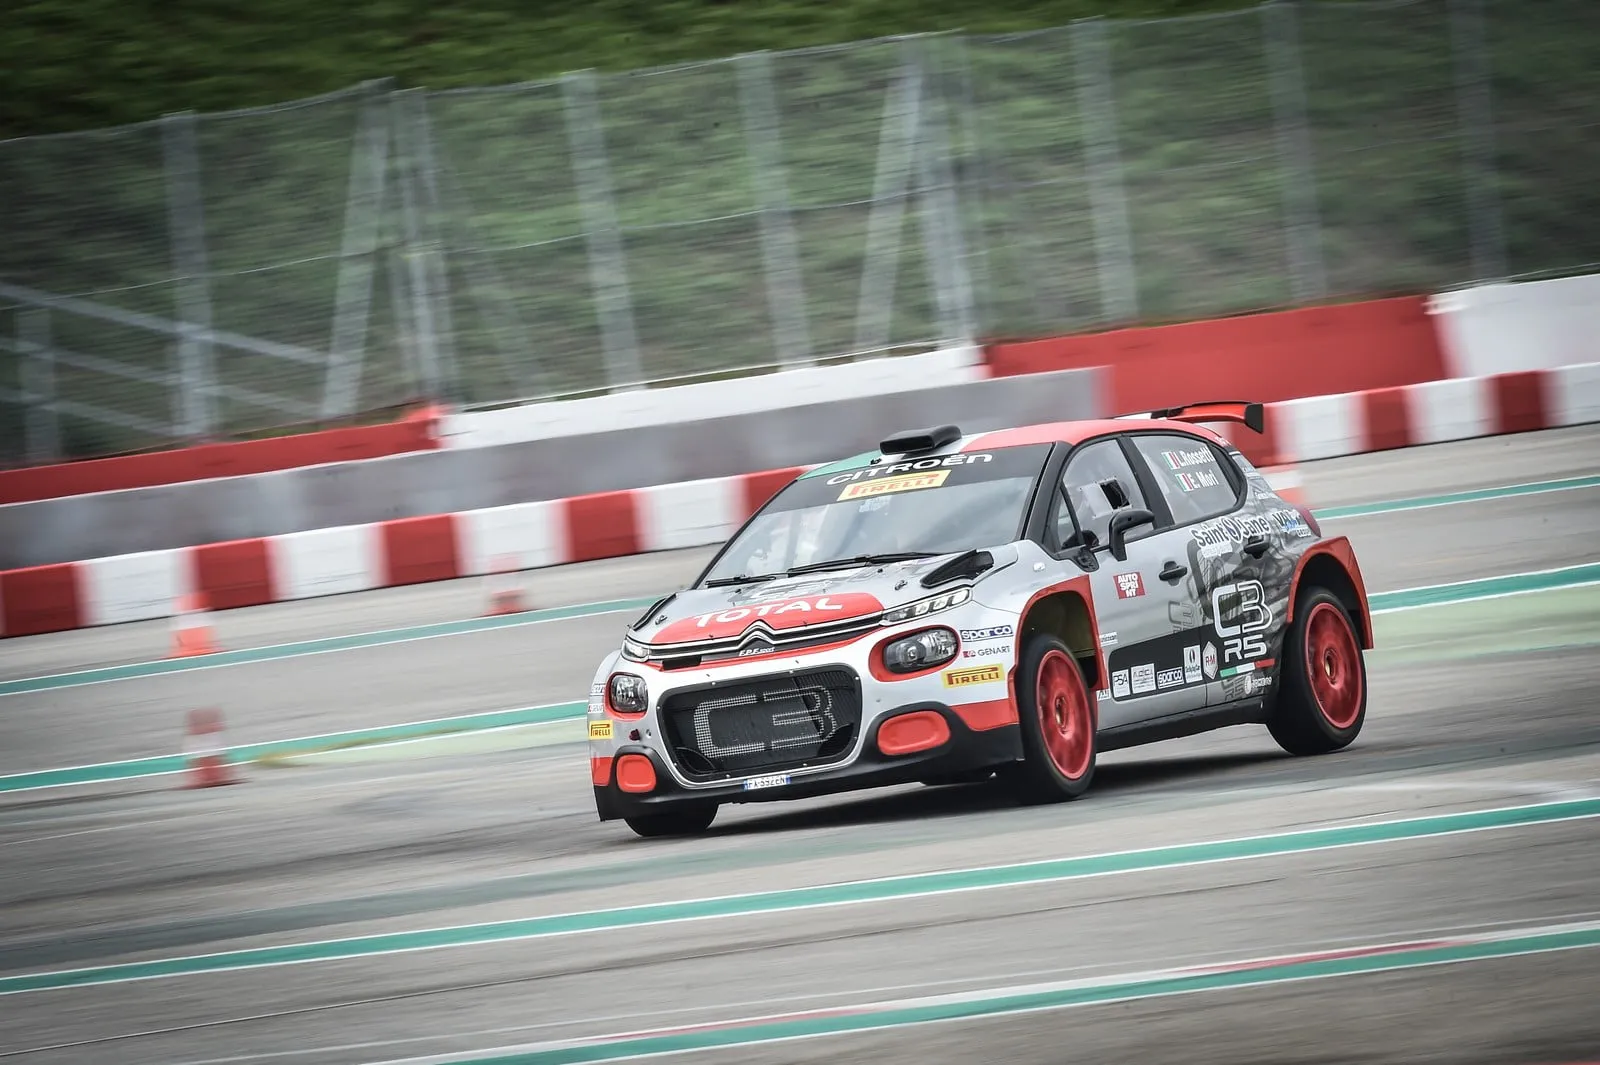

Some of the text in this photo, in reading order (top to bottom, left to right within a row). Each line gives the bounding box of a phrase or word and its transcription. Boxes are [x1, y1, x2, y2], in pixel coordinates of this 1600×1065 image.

[847, 474, 940, 497] PIRELLI
[1191, 525, 1229, 547] Saint
[1238, 517, 1270, 537] Jane
[1117, 573, 1138, 583] AUTO
[1120, 581, 1139, 591] SPRI
[1126, 589, 1136, 597] NT
[693, 597, 843, 628] TOTAL
[1212, 579, 1272, 638] C3
[961, 626, 1011, 642] sparco
[977, 645, 1010, 657] GENART
[1224, 633, 1267, 663] R5
[946, 666, 1000, 685] PIRELLI
[590, 723, 611, 737] PIRELLI
[693, 685, 837, 758] C3
